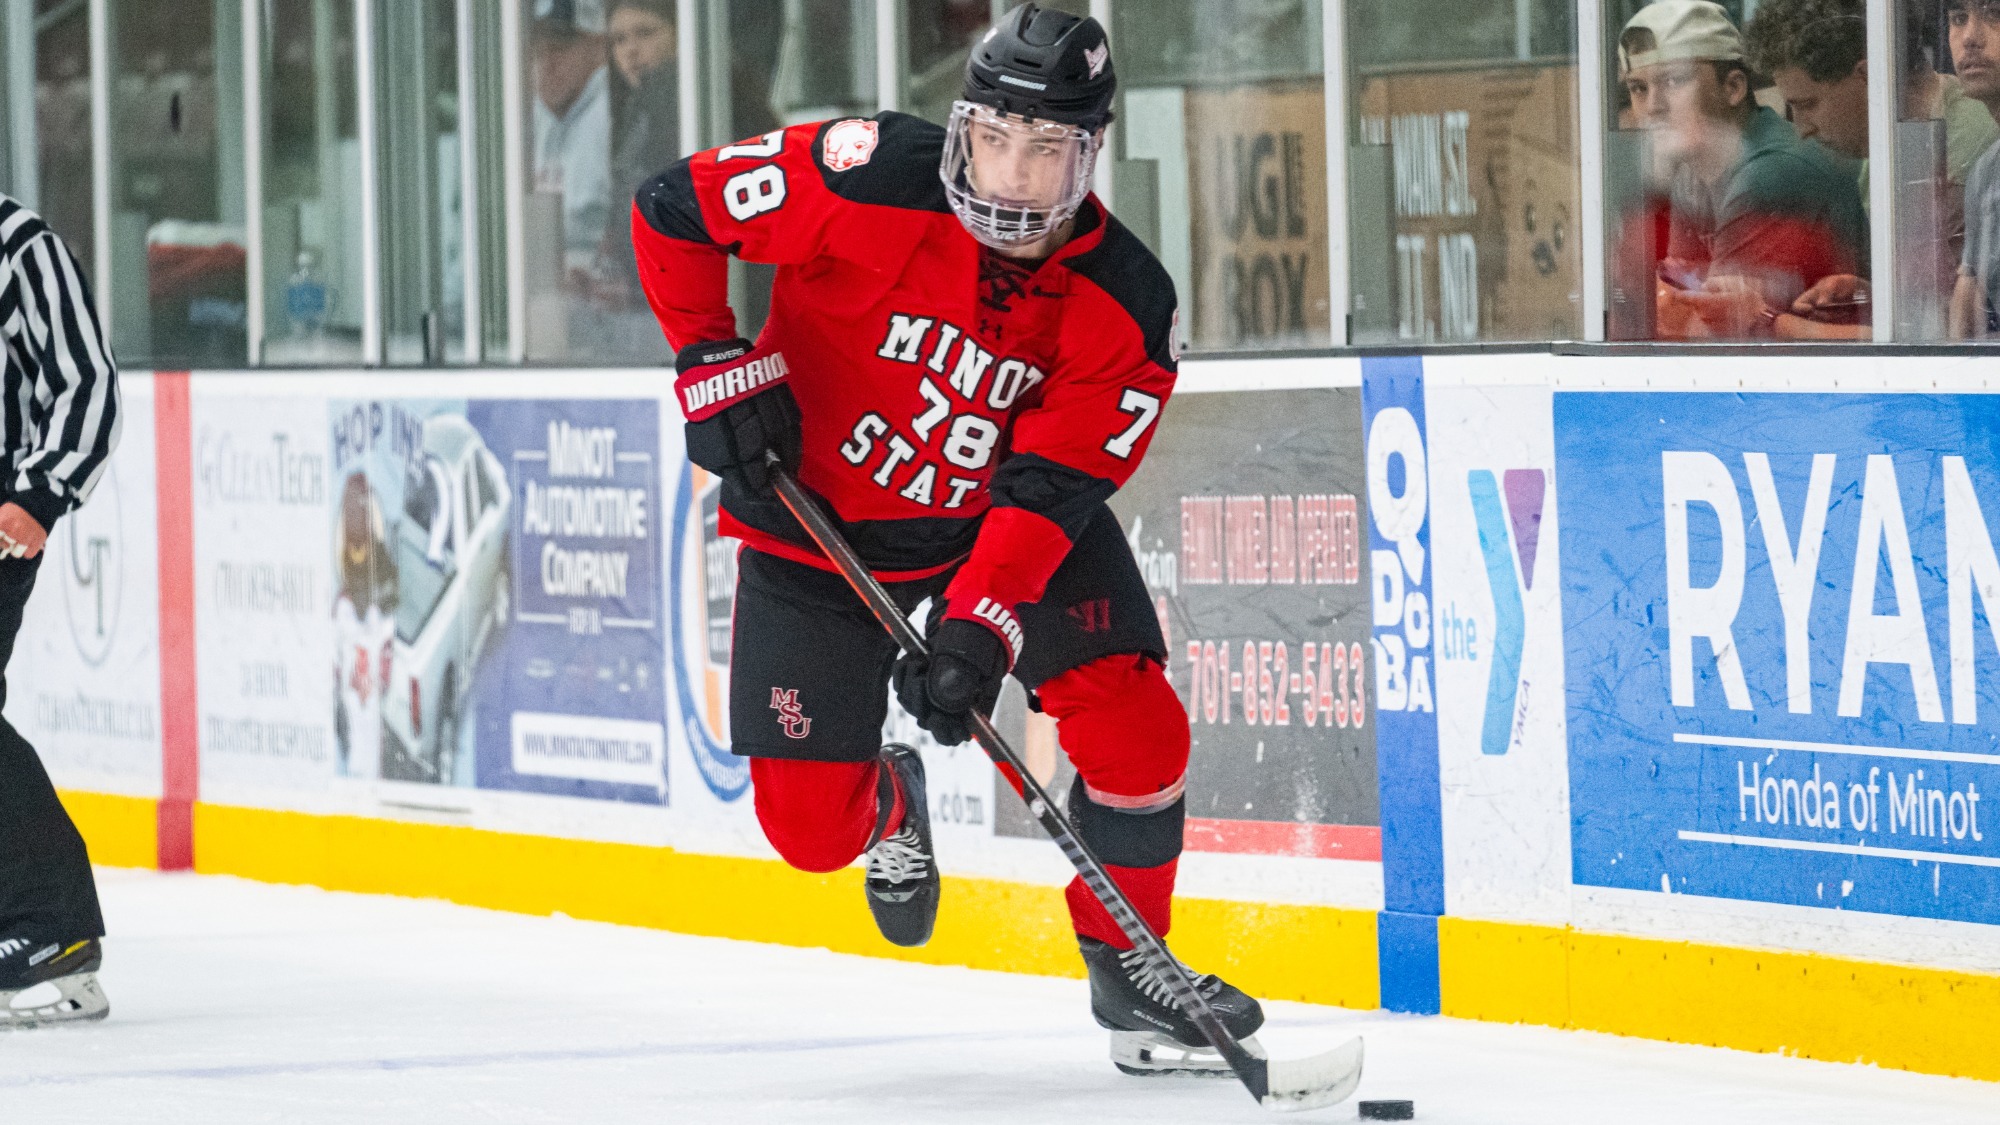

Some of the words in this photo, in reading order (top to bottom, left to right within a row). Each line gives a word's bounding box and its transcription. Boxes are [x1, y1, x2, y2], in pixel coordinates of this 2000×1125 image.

[714, 128, 788, 222] 78
[683, 351, 790, 413] WARRIO
[702, 347, 745, 363] BEAVERS
[333, 399, 384, 472] HOP
[547, 418, 616, 480] MINOT
[910, 376, 1000, 470] 78
[1102, 387, 1161, 460] 7
[839, 412, 981, 509] STAT
[523, 478, 648, 540] AUTOMOTIVE
[540, 538, 630, 600] COMPANY
[1661, 450, 2000, 725] RYAN
[1442, 601, 1478, 662] the
[769, 686, 813, 739] MSU
[1186, 639, 1367, 730] 701-852-5433
[1738, 759, 1842, 830] Honda
[1849, 766, 1881, 833] of
[1886, 768, 1984, 842] Minot
